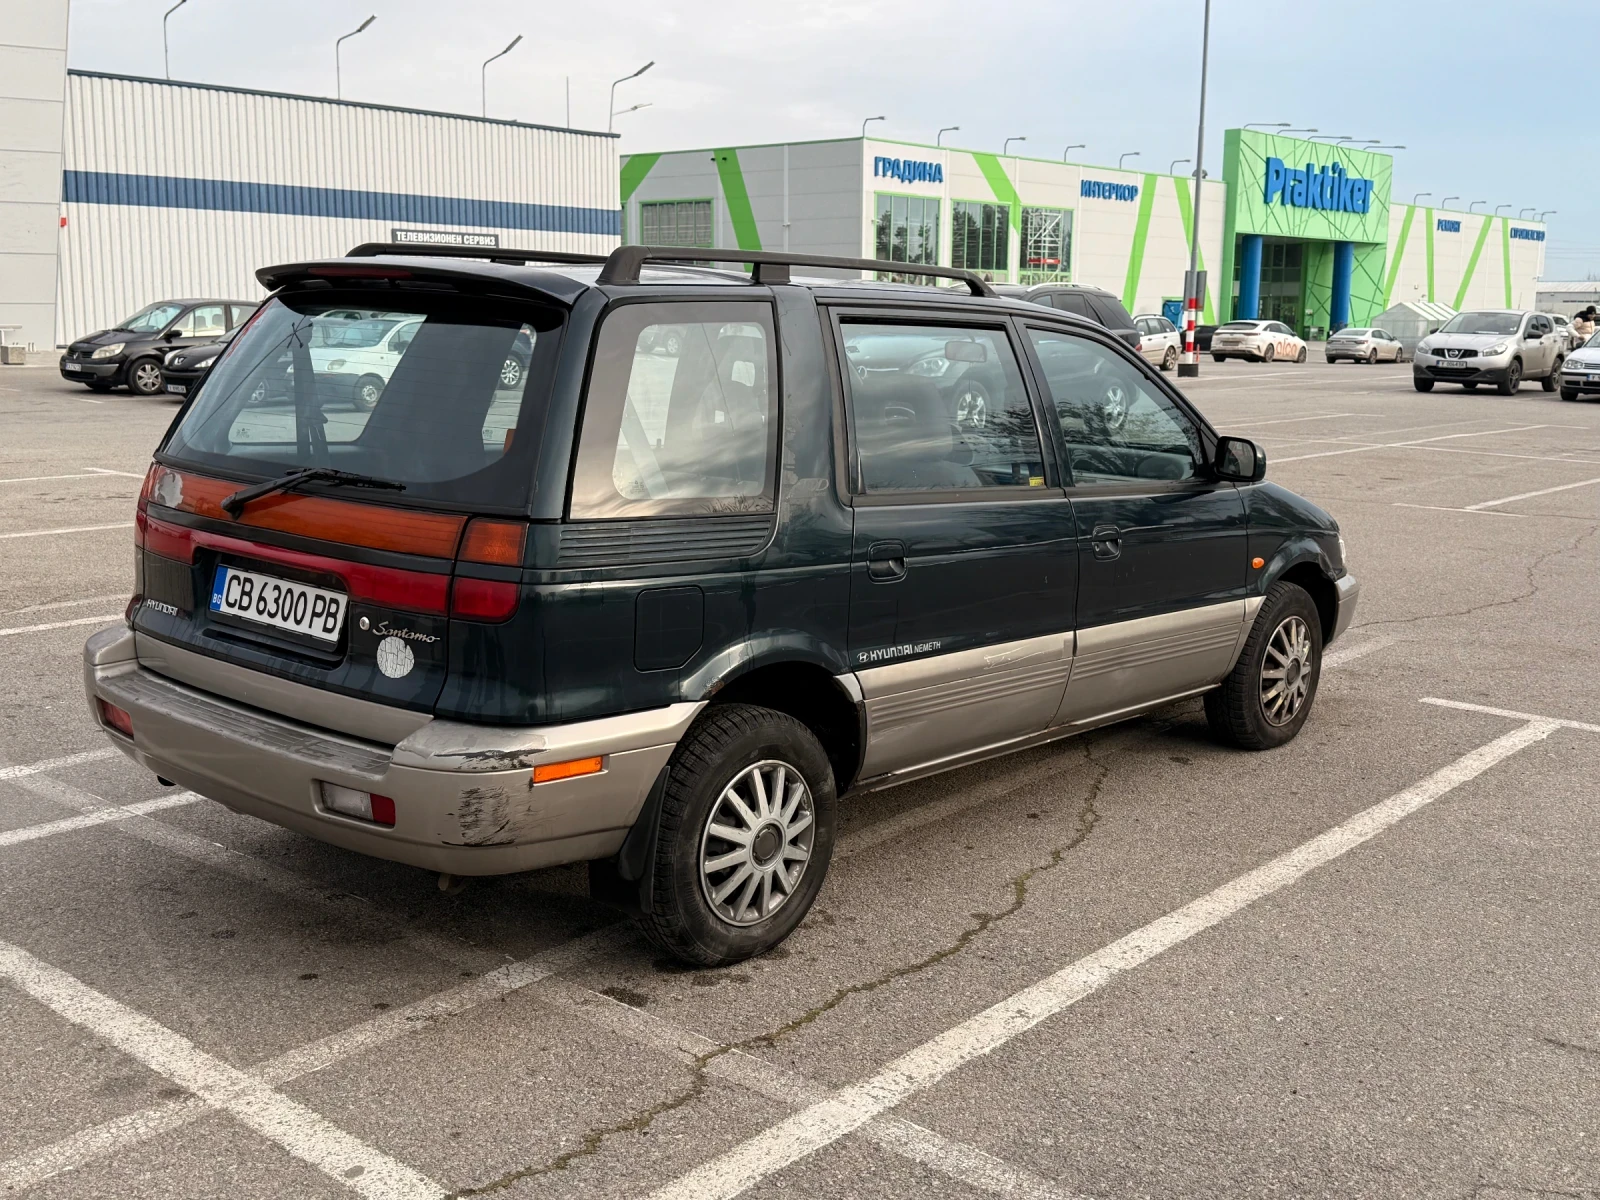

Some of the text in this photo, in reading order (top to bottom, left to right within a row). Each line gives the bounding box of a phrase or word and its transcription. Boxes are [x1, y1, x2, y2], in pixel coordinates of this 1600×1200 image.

[874, 156, 943, 184] ГРАДИНА
[1081, 179, 1138, 202] ИНТЕРИОР
[1264, 157, 1374, 214] Praktiker
[1437, 218, 1462, 233] РЕМОНТ
[396, 231, 495, 246] ТЕЛЕВИЗИОНЕН СЕРВИЗ
[147, 599, 178, 616] HYUNDAI
[212, 593, 222, 605] BG
[225, 574, 340, 634] CB 6300 PB
[372, 621, 440, 643] Santamo
[869, 641, 941, 661] HYUNDAI NEMETH
